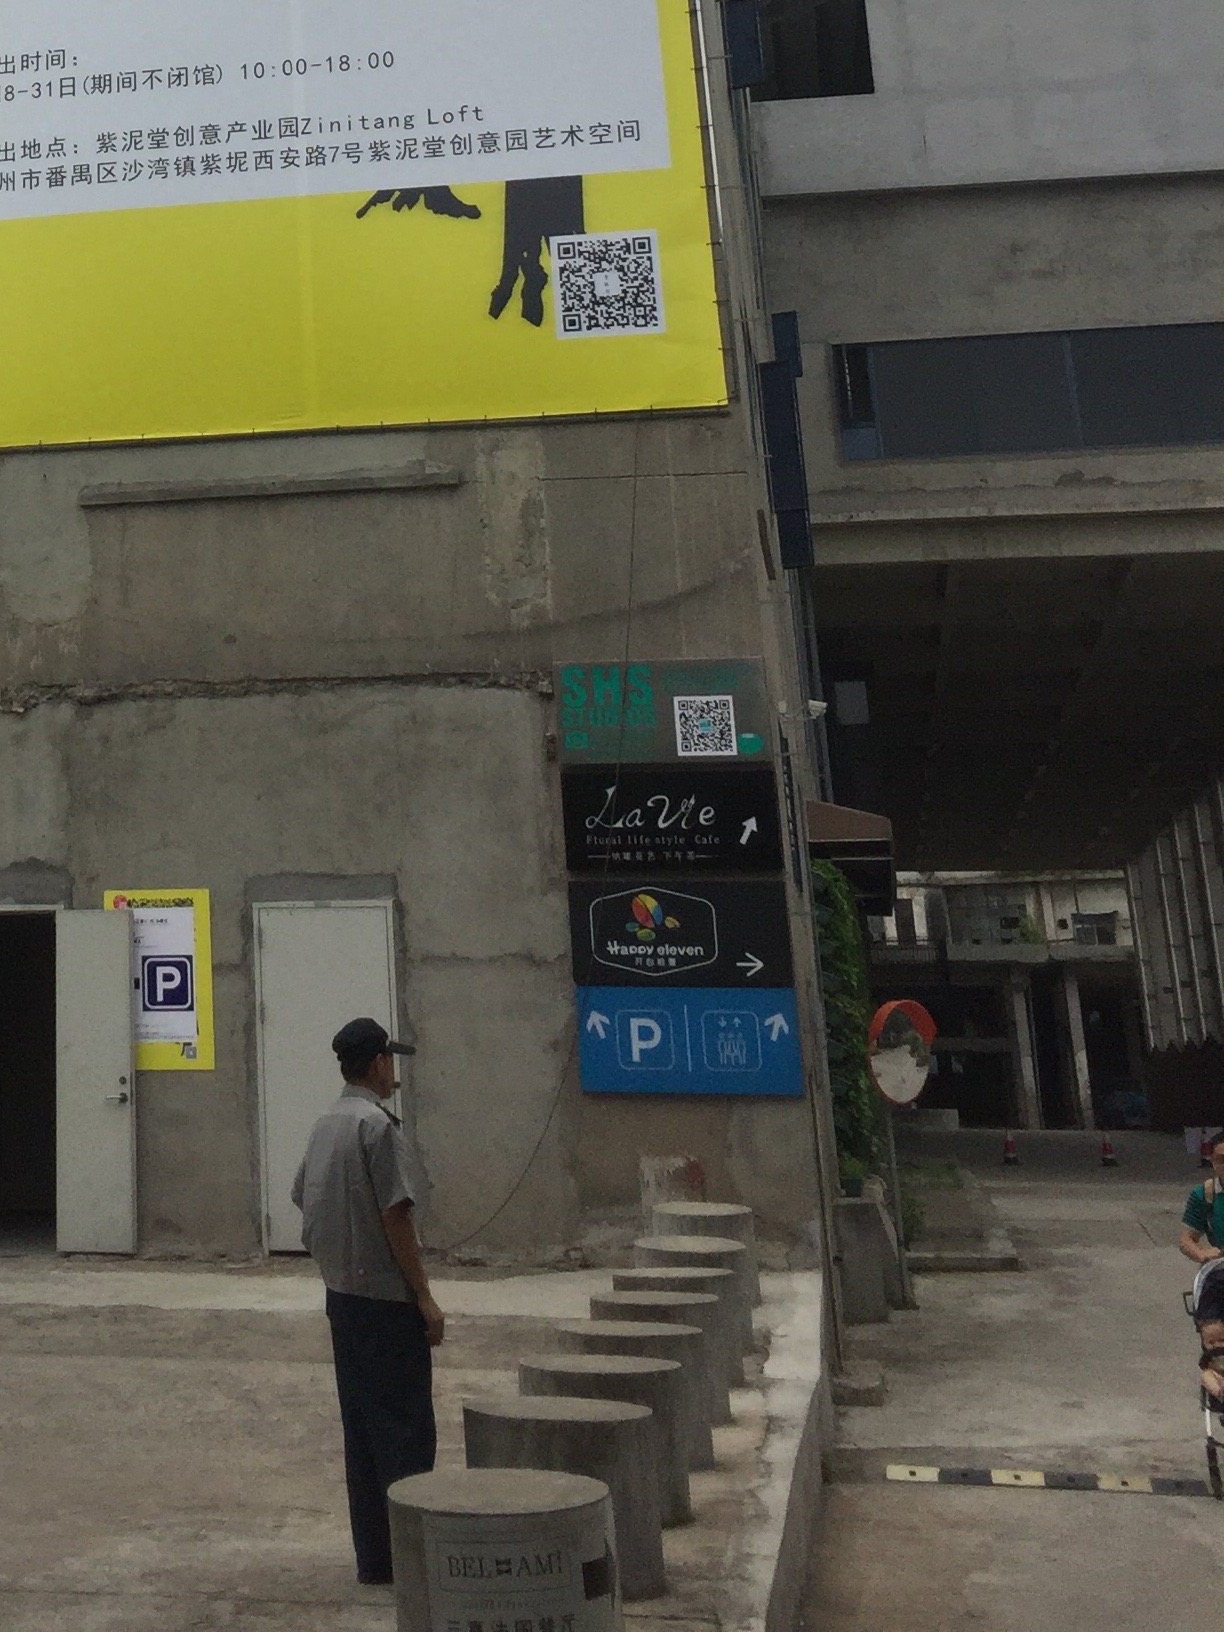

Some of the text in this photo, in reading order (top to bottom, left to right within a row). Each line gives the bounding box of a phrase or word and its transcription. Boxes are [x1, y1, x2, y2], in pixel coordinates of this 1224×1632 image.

[240, 50, 395, 80] 10:00-18:00
[426, 105, 484, 126] Loft
[560, 665, 654, 707] SHS
[560, 705, 657, 728] STUDOS
[656, 943, 704, 956] eleven
[156, 966, 181, 1002] P
[630, 1018, 662, 1063] P
[446, 1554, 492, 1579] BEL
